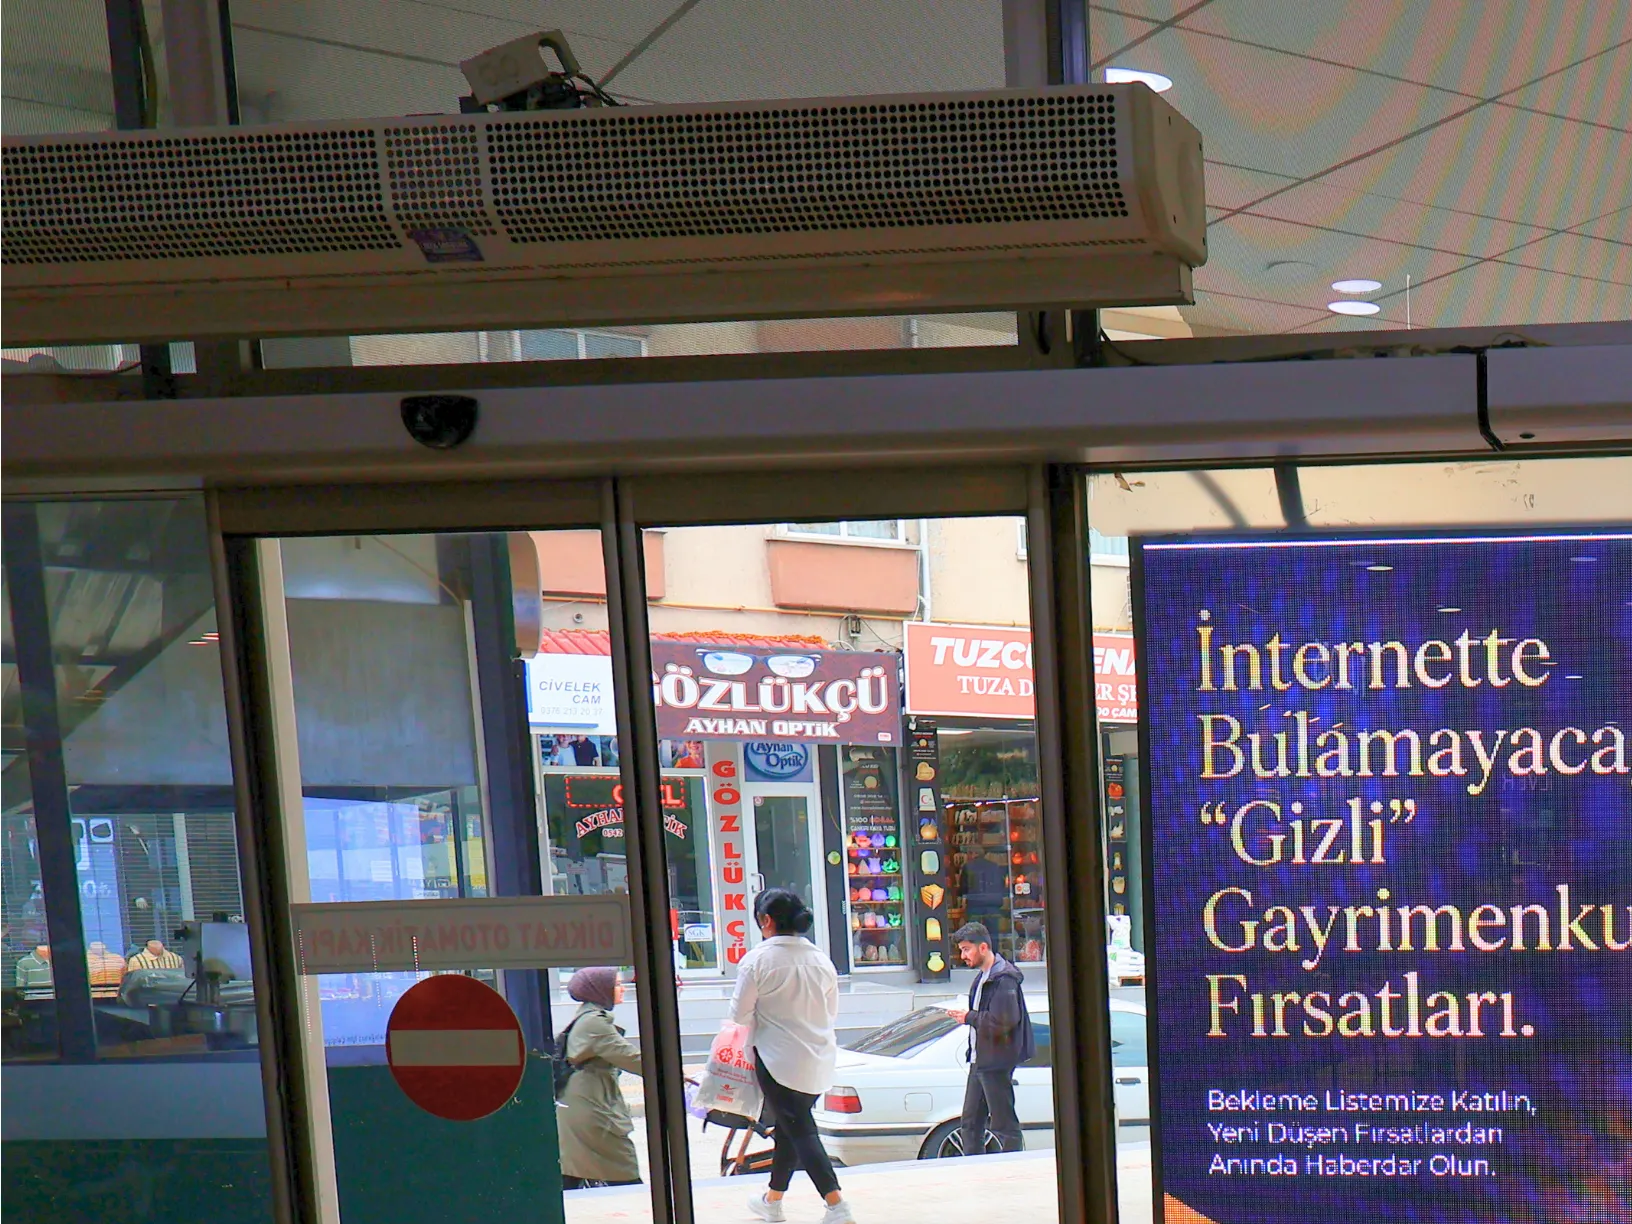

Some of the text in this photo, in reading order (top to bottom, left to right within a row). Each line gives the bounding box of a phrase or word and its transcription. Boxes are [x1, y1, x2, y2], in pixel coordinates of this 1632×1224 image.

[930, 636, 1034, 671] TUZC
[1196, 609, 1551, 691] İnternette
[539, 679, 602, 693] CİVELEK
[956, 675, 1015, 696] TUZA
[572, 694, 602, 705] CAM
[683, 716, 768, 736] AYHAN
[765, 752, 803, 771] Optik
[1205, 971, 1535, 1038] Fırsatları.
[1207, 1089, 1538, 1116] Bekleme Listemize Katılın,
[1207, 1121, 1504, 1149] Yeni Düşen Fırsatlardan
[1208, 1153, 1497, 1177] Anında Haberdar Olun.
